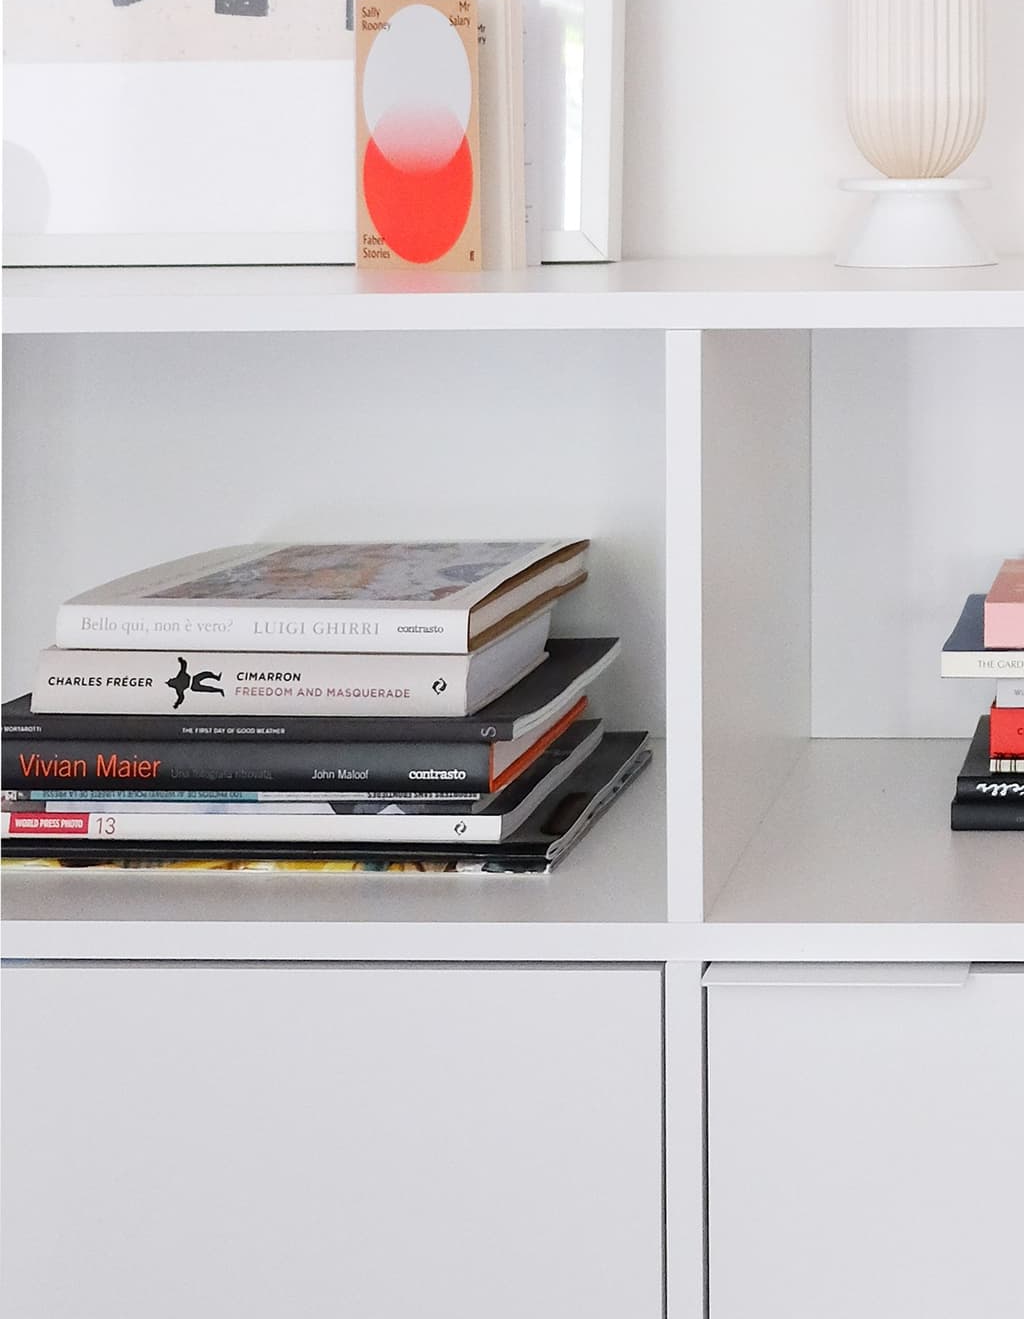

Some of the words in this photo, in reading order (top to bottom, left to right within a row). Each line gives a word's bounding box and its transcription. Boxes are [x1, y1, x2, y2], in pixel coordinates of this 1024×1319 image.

[459, 0, 471, 12] Mr
[361, 6, 381, 19] Sally
[361, 20, 391, 32] Rooney
[448, 15, 471, 27] Salary
[362, 234, 385, 246] Faber
[362, 247, 391, 259] Stories
[81, 616, 118, 631] Bello
[121, 620, 150, 638] qui,
[154, 622, 181, 632] non
[185, 618, 193, 632] è
[196, 618, 234, 633] vero?
[253, 620, 305, 635] LUIGI
[312, 621, 380, 636] GHIRRI
[397, 623, 445, 634] contrasto
[978, 660, 995, 669] THE
[48, 676, 103, 687] CHARLES
[106, 674, 153, 688] FRÉGER
[236, 671, 302, 682] CIMARRON
[235, 686, 293, 698] FREEDOM
[296, 687, 323, 698] AND
[326, 687, 411, 699] MASQUERADE
[19, 754, 87, 777] Vivian
[96, 754, 161, 778] Maier
[311, 769, 335, 780] John
[337, 769, 369, 780] Maloof
[408, 768, 466, 780] contrasto
[14, 818, 39, 829] WORLD
[39, 818, 61, 829] PRESS
[61, 818, 84, 829] PHOTO
[96, 817, 116, 835] 13
